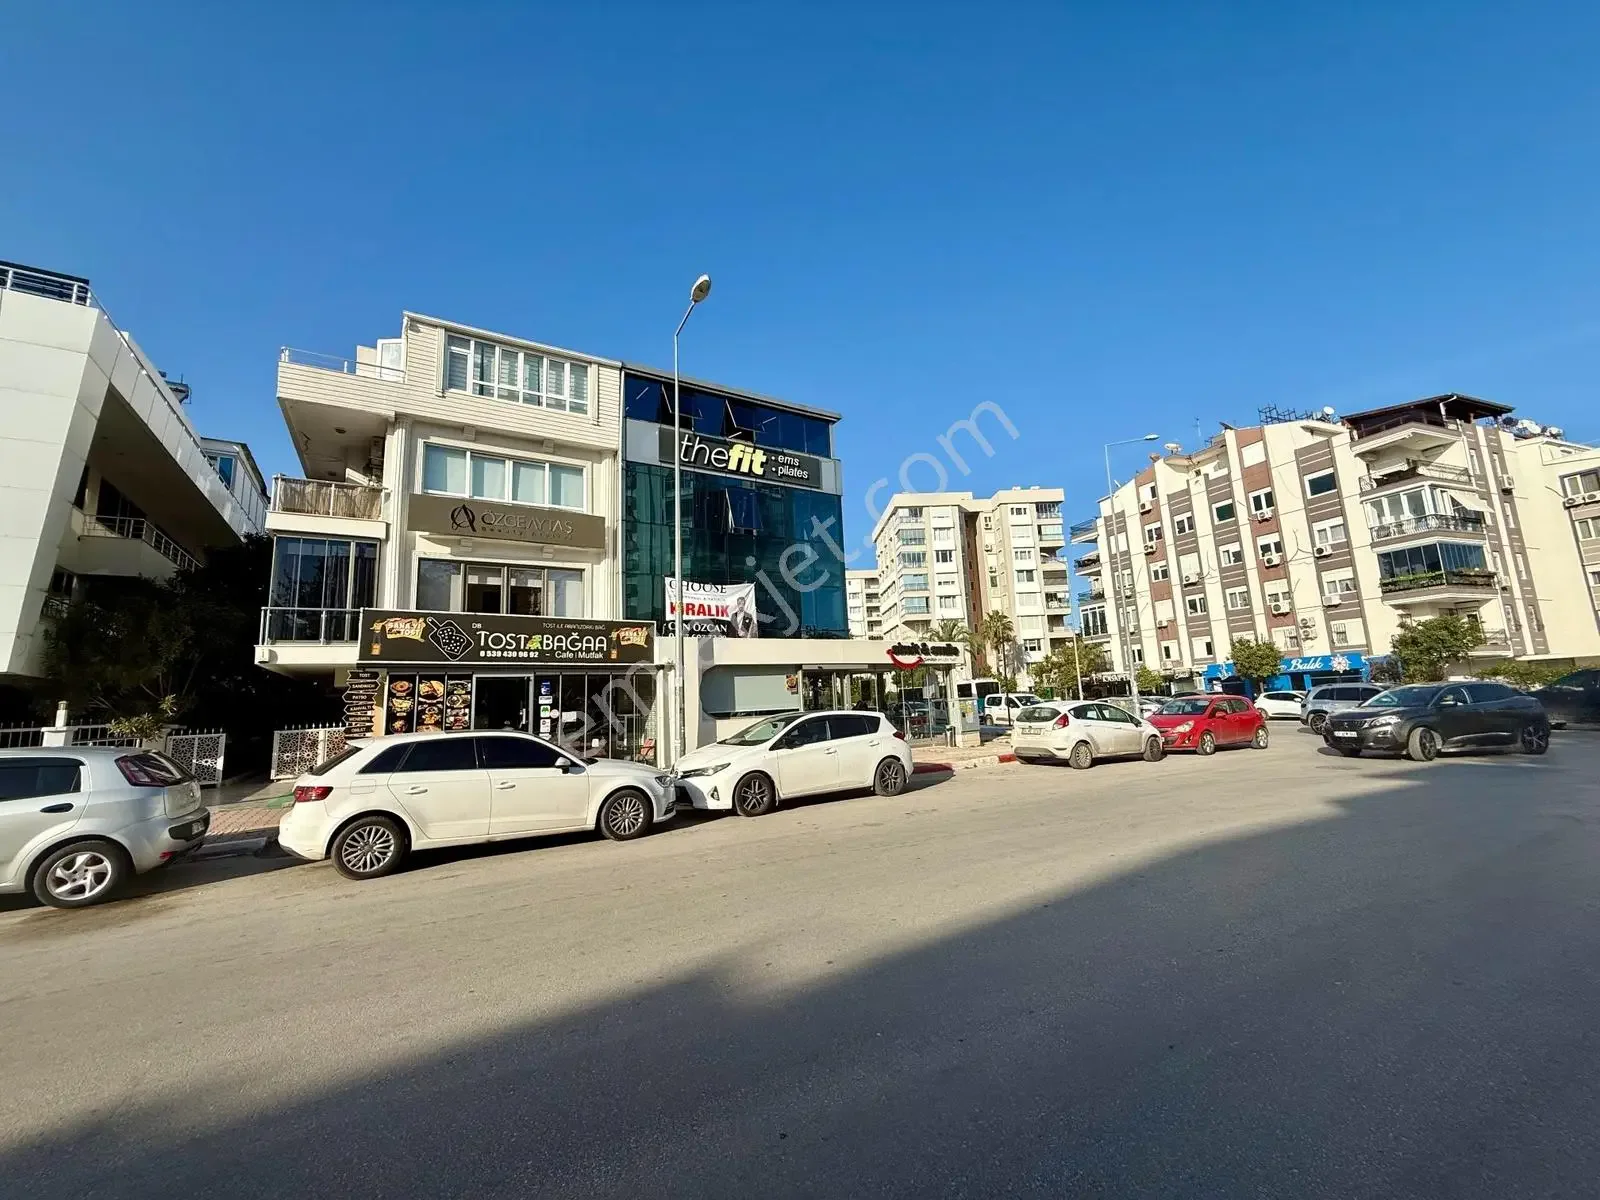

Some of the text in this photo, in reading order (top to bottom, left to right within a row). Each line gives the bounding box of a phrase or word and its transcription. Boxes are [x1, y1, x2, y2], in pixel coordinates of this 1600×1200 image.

[778, 455, 799, 466] ems
[778, 466, 808, 479] pilates
[670, 602, 729, 617] KRALIK
[668, 622, 727, 632] CN ÖZCAN
[476, 631, 529, 650] TOST
[543, 633, 607, 651] BAĞAA
[555, 651, 604, 659] Cafe Mutfak
